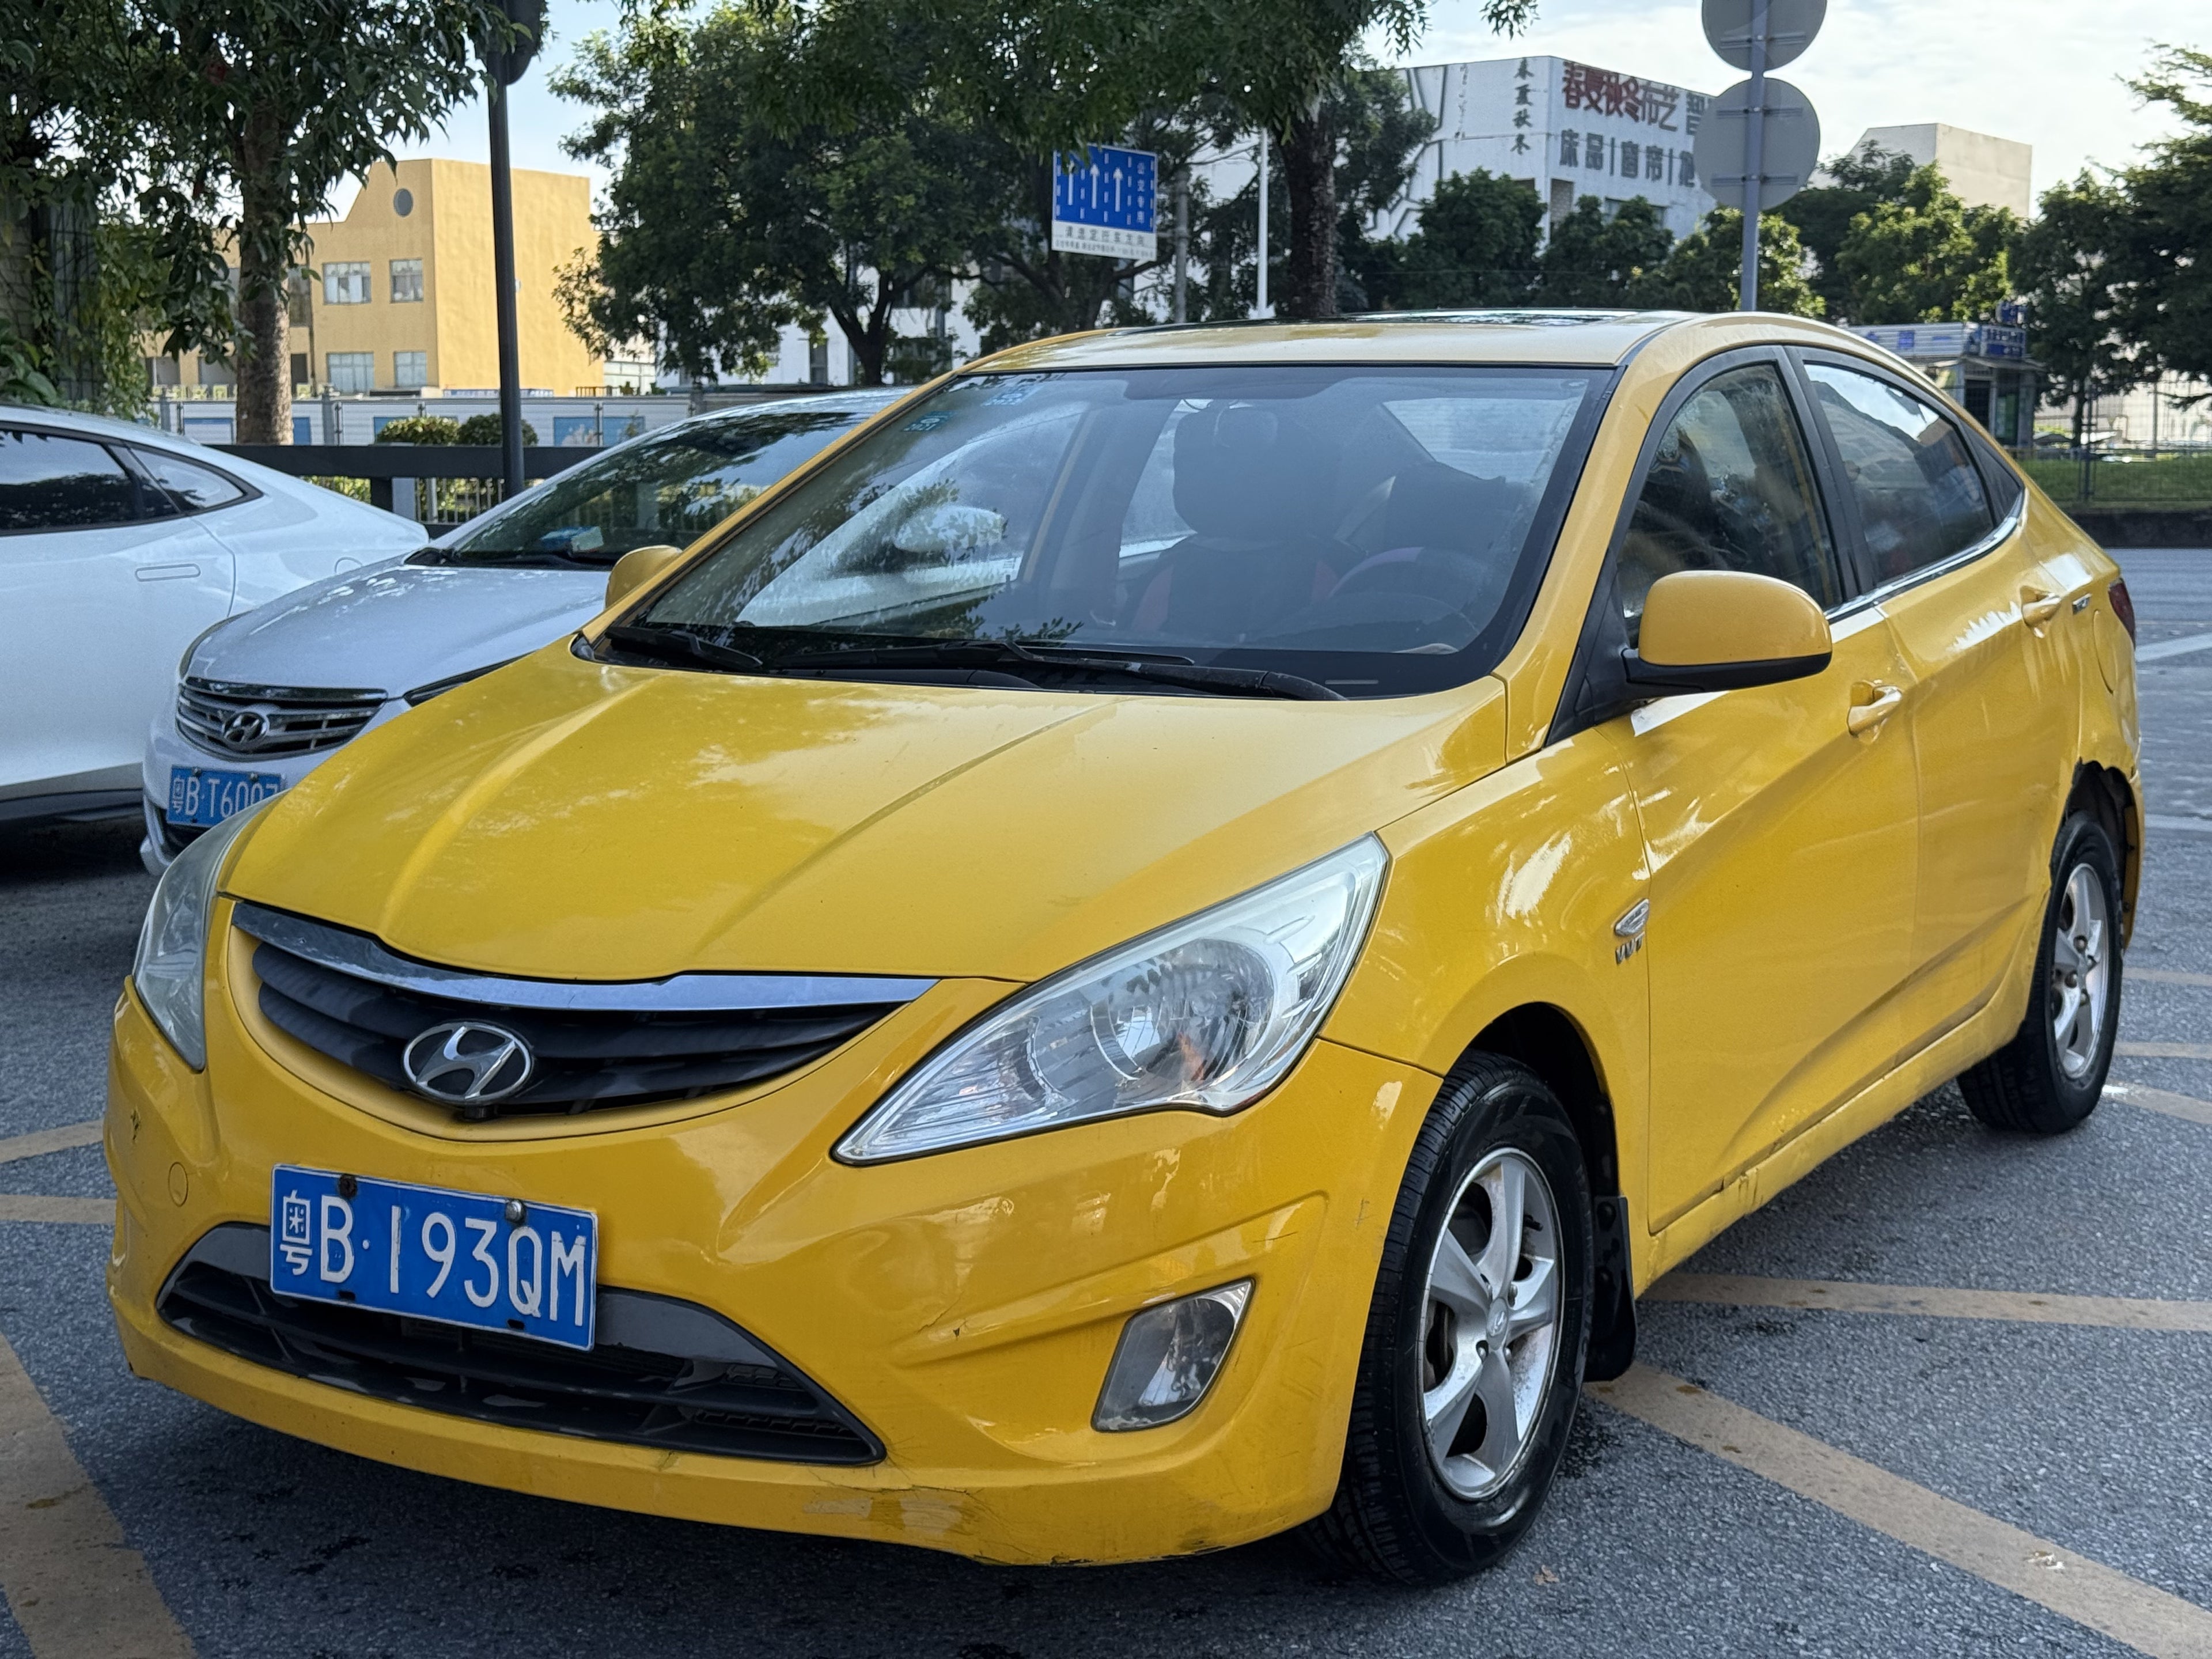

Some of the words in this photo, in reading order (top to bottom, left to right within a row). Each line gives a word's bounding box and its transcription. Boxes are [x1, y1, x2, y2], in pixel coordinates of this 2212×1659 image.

[1510, 57, 1535, 155] 春夏秋冬
[279, 1190, 588, 1327] 粤B·193QM
